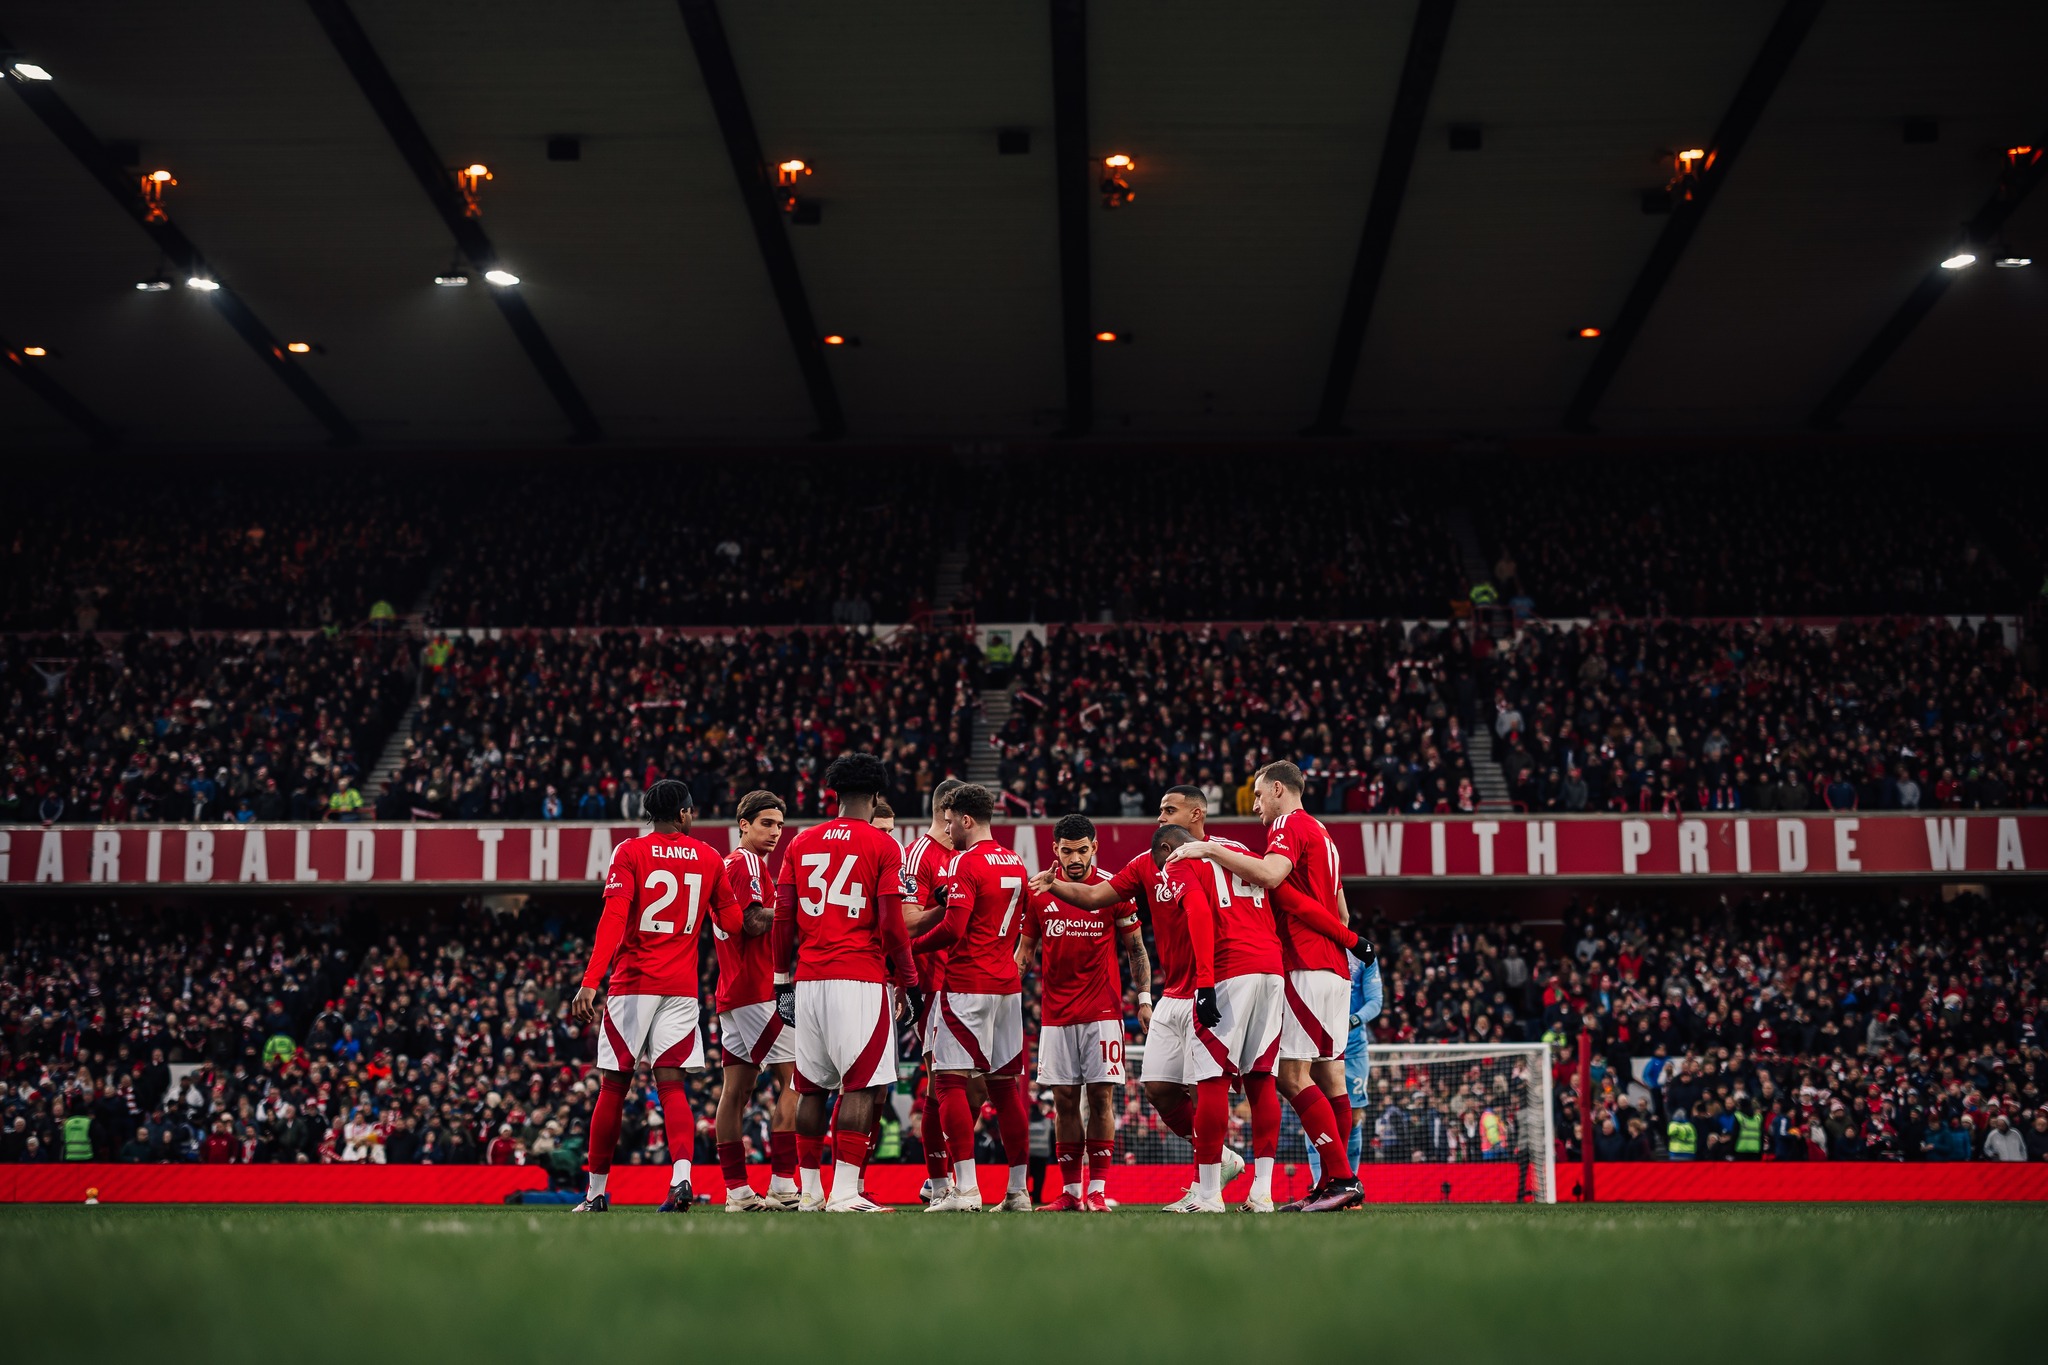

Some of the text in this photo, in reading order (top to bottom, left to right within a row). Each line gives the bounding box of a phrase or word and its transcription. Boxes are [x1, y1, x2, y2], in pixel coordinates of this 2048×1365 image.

[477, 827, 654, 882] THA
[1361, 820, 1557, 877] WITH
[1621, 817, 1862, 875] PRIDE
[1925, 815, 2027, 871] WA
[651, 845, 699, 861] ELANGA
[822, 828, 851, 841] AINA
[639, 869, 703, 935] 21
[799, 852, 867, 919] 34
[998, 876, 1022, 937] 7
[1201, 853, 1265, 909] 14
[1099, 1040, 1121, 1063] 10
